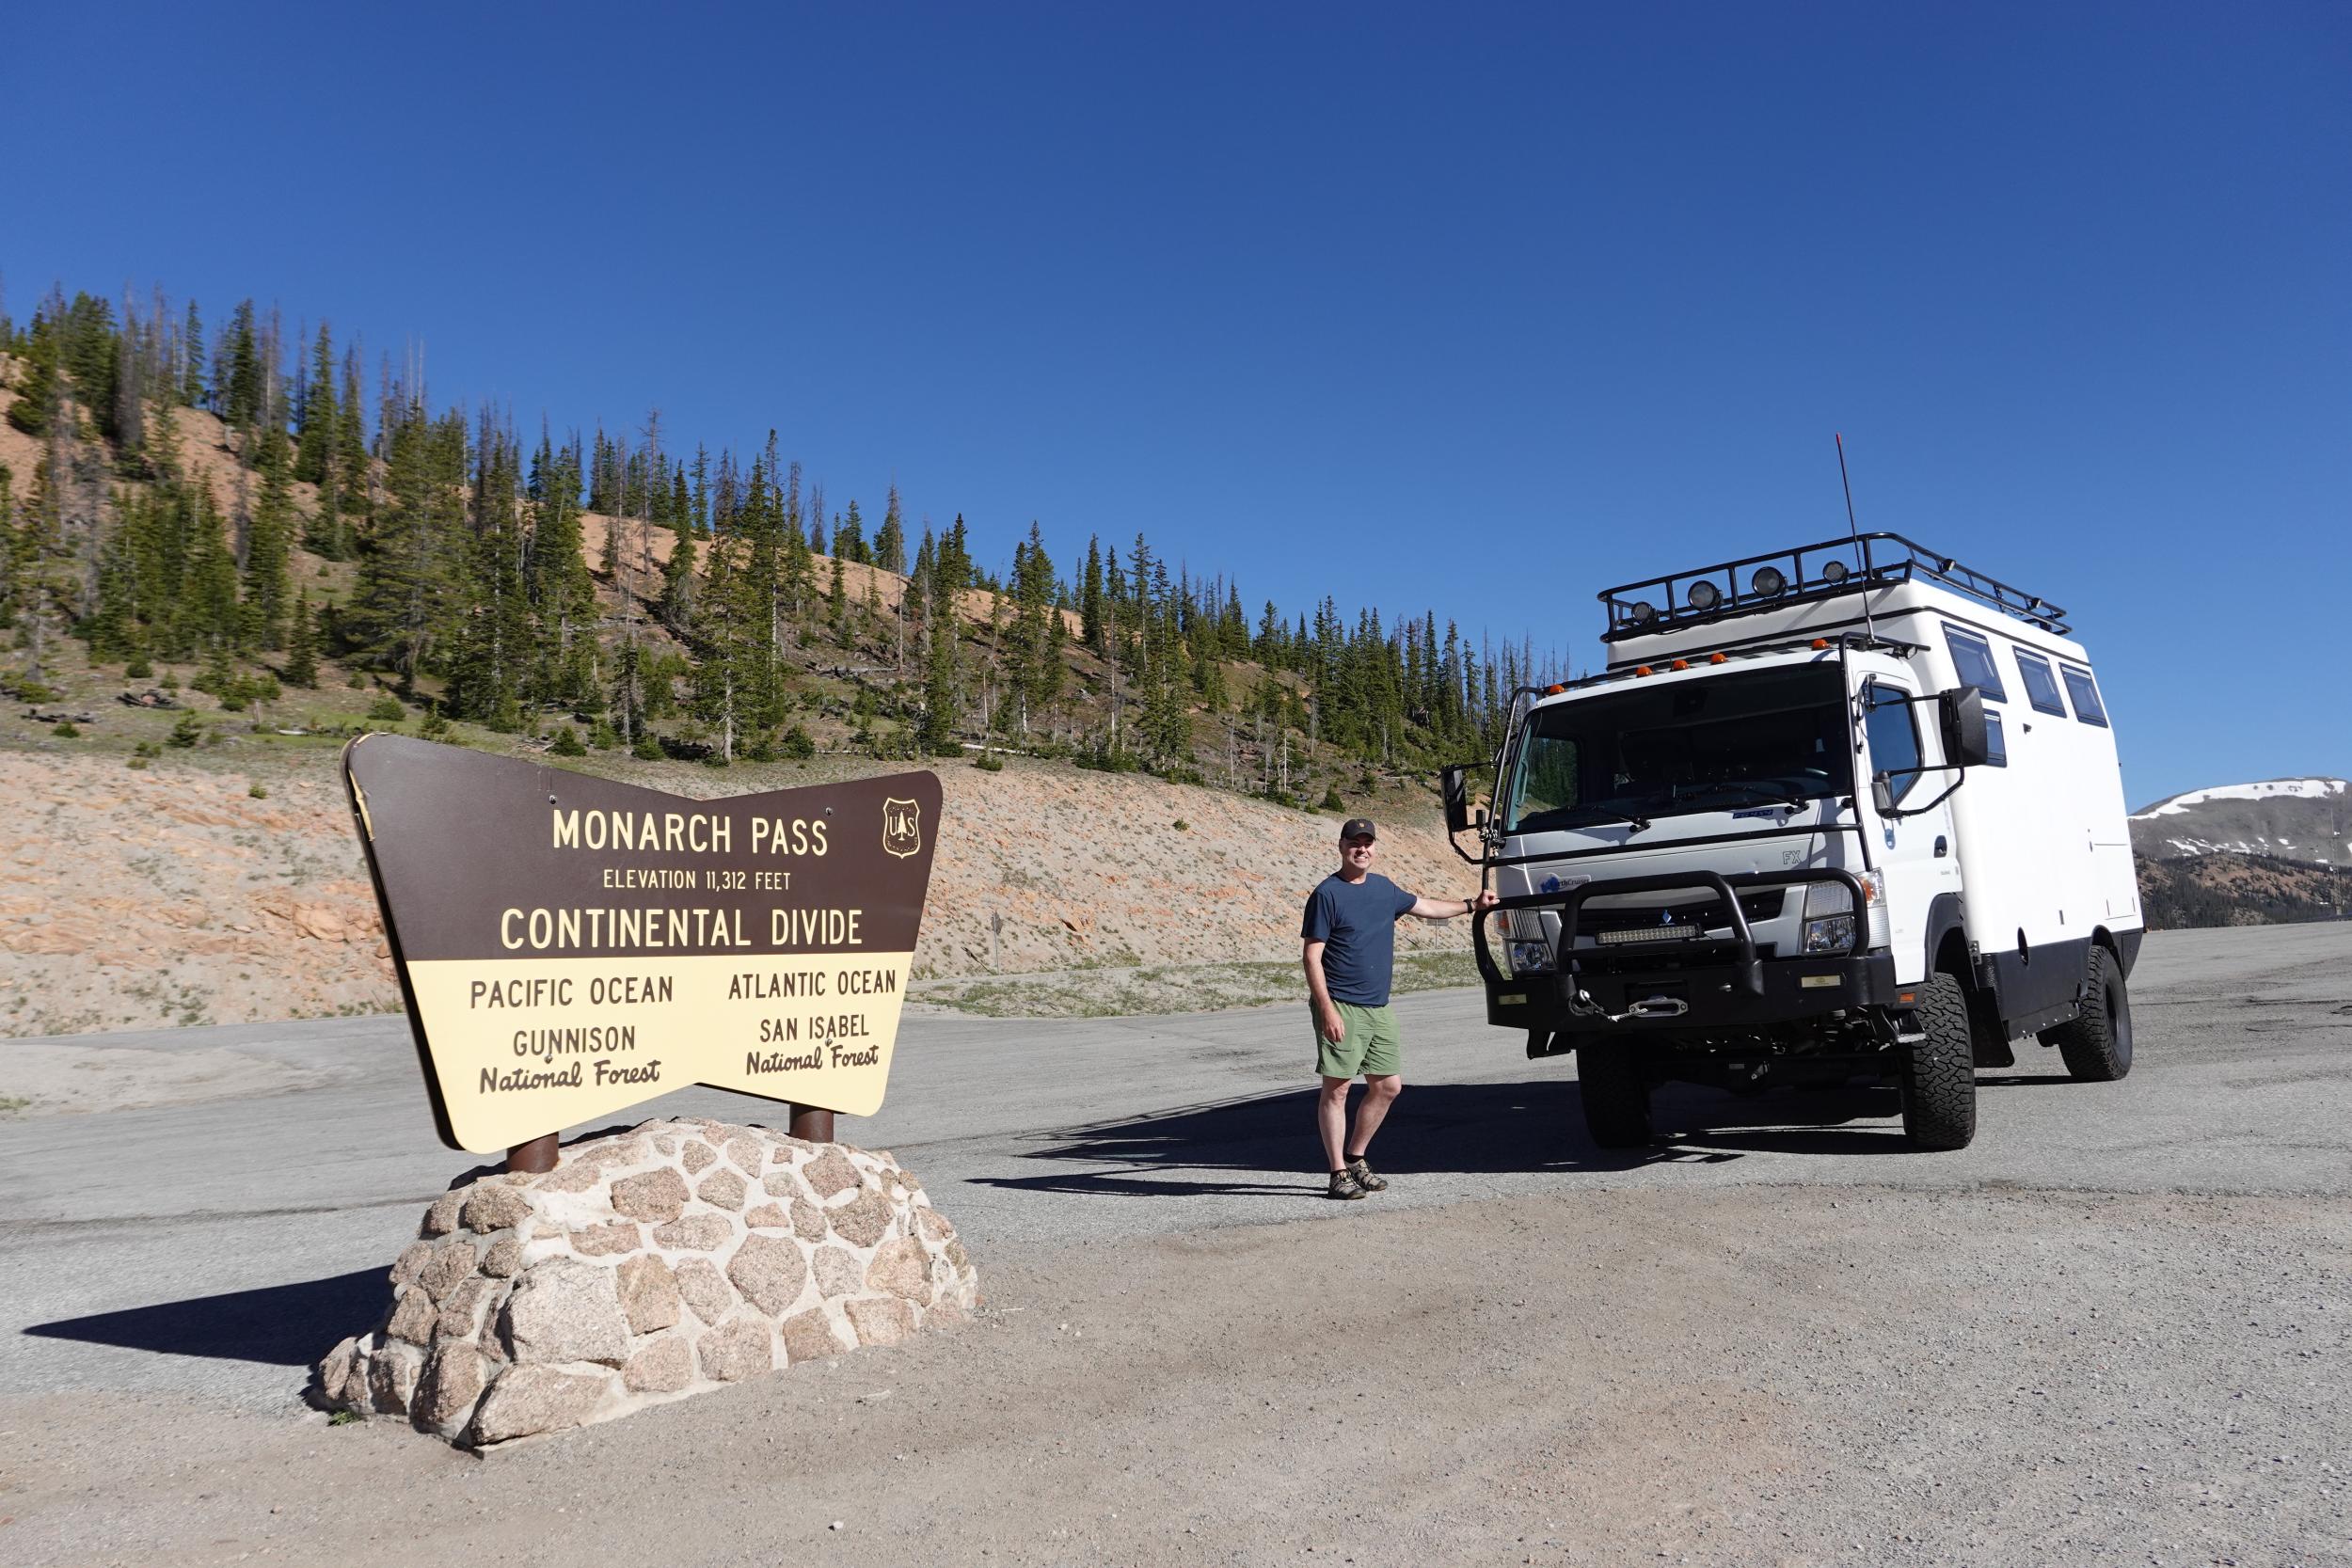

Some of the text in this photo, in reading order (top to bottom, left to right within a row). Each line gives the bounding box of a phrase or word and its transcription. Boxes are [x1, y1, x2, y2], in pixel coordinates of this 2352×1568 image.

[553, 809, 828, 858] MONARCH PASS
[1782, 849, 1802, 865] FX
[603, 868, 792, 893] ELEVATION 11,312 FEET
[501, 908, 864, 950] CONTINENTAL DIVIDE
[471, 975, 674, 1010] PACIFIC OCEAN
[728, 969, 897, 1001] ATLANTIC OCEAN
[513, 1025, 636, 1056] GUNNISON
[759, 1014, 870, 1044] SAN ISABEL
[746, 1044, 880, 1076] National Forest
[480, 1059, 661, 1094] National Forest
